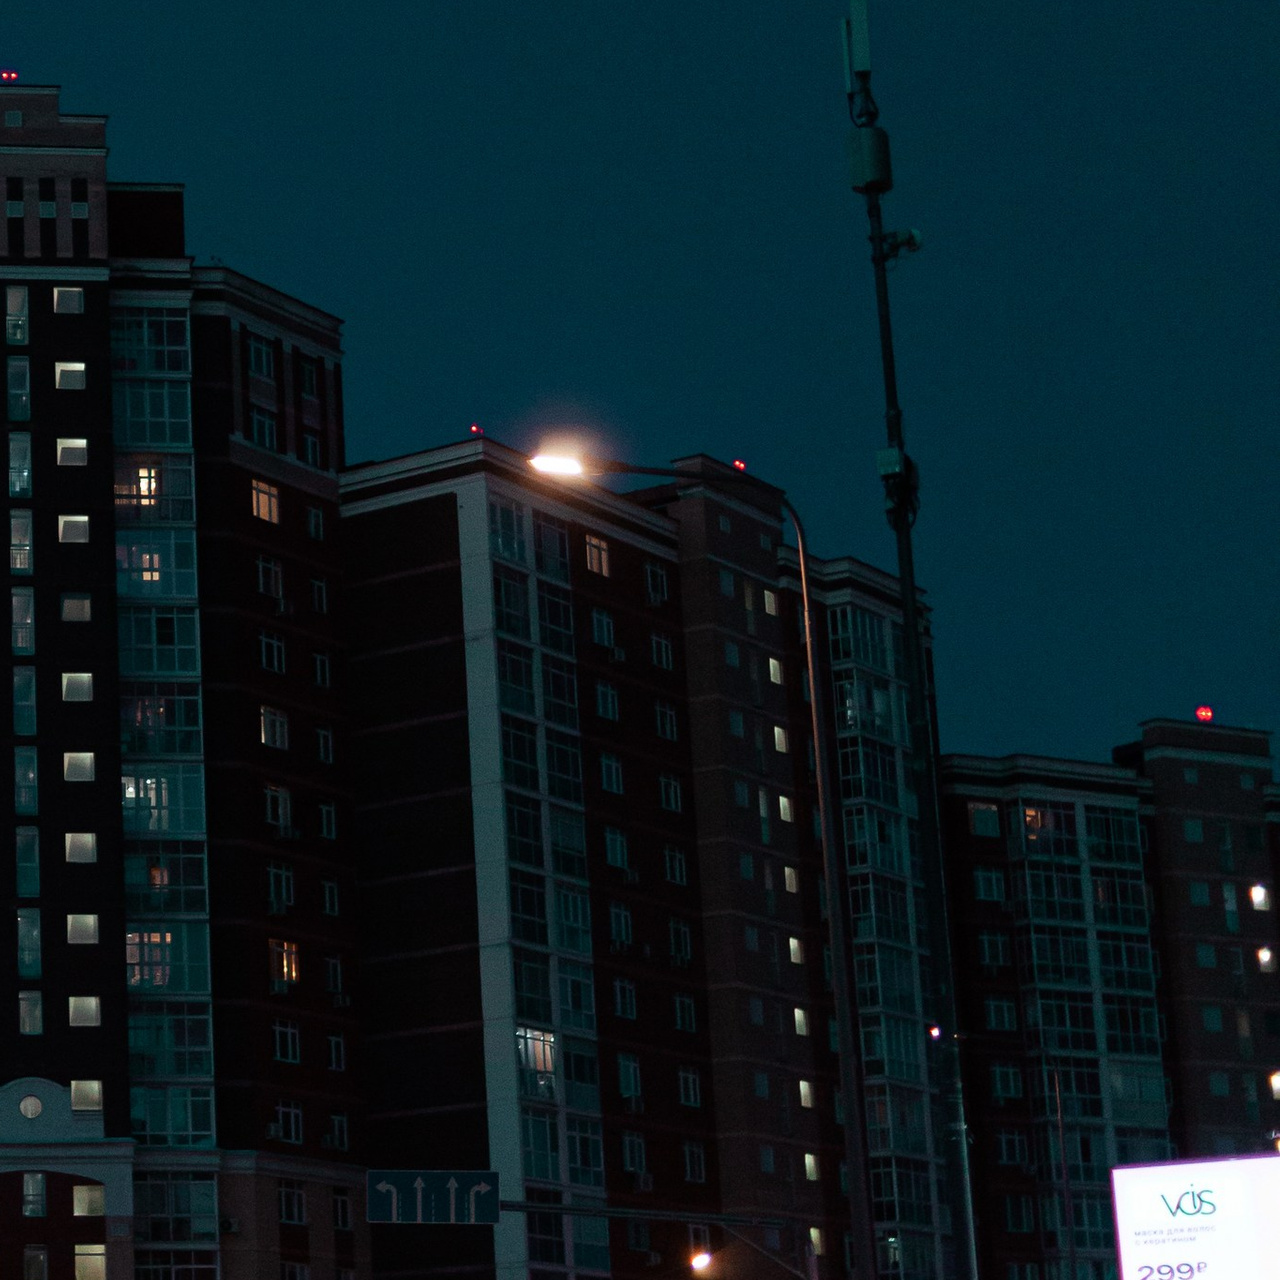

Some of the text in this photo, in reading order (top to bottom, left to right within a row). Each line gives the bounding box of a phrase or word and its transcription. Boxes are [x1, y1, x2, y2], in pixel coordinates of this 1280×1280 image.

[1166, 1227, 1185, 1236] для
[1187, 1224, 1217, 1233] волос
[1143, 1235, 1197, 1246] кератином
